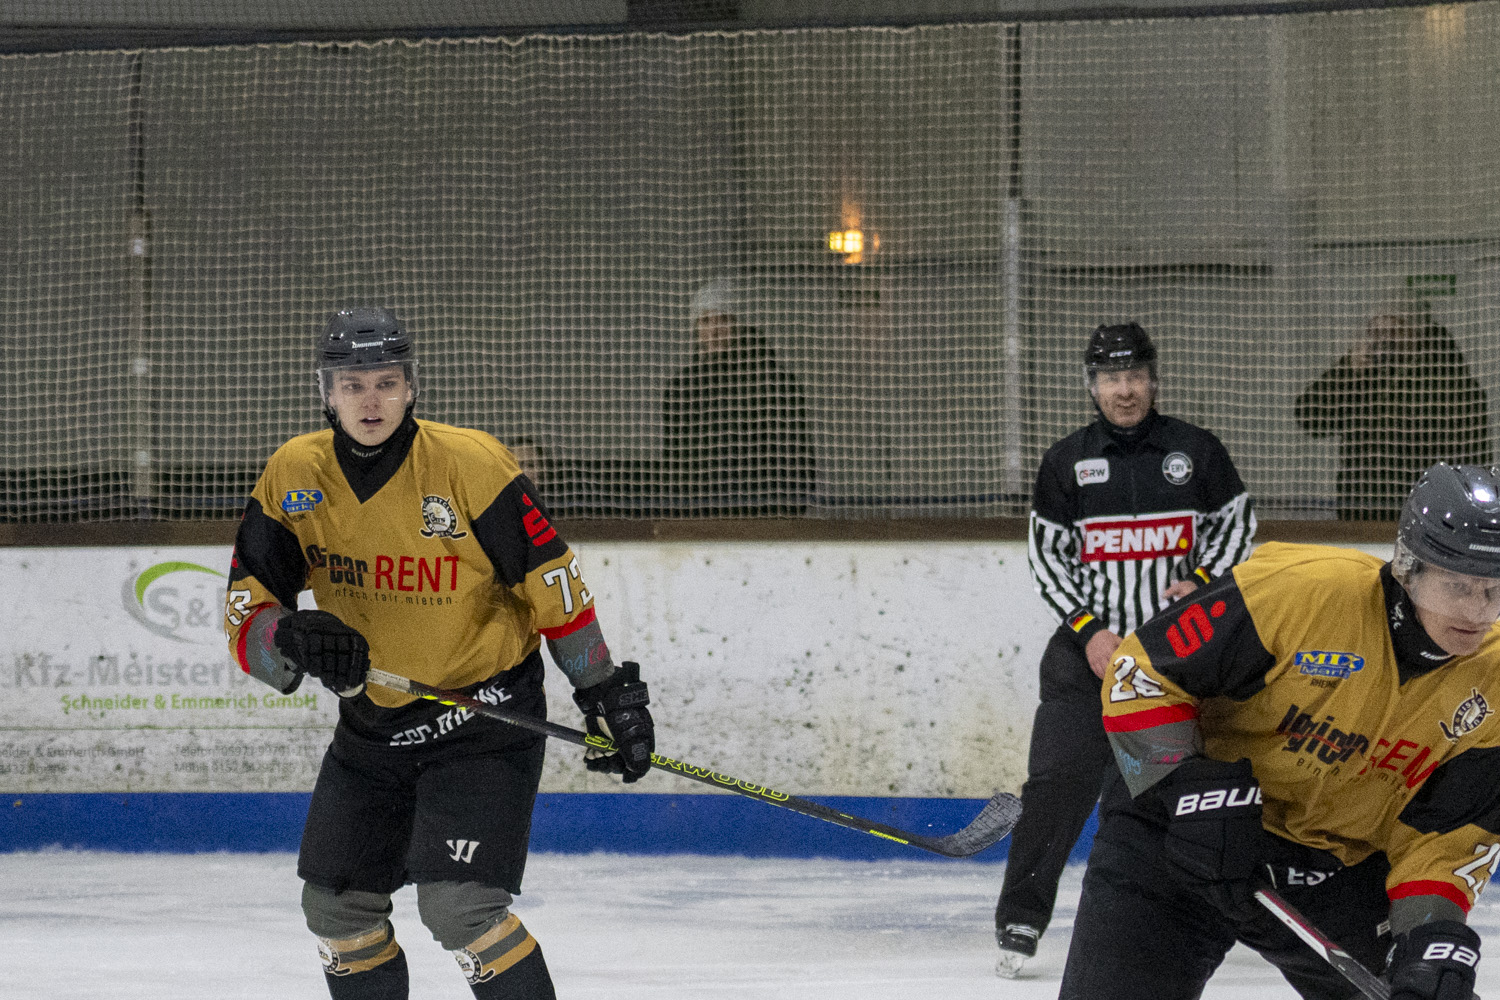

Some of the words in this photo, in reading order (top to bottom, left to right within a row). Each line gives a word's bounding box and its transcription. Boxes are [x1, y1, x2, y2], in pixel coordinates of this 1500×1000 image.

[288, 491, 319, 502] IX
[375, 554, 460, 593] RENT
[61, 692, 148, 711] Schneider
[154, 694, 167, 710] &
[171, 692, 257, 711] Emmerich
[262, 693, 318, 710] GmbH
